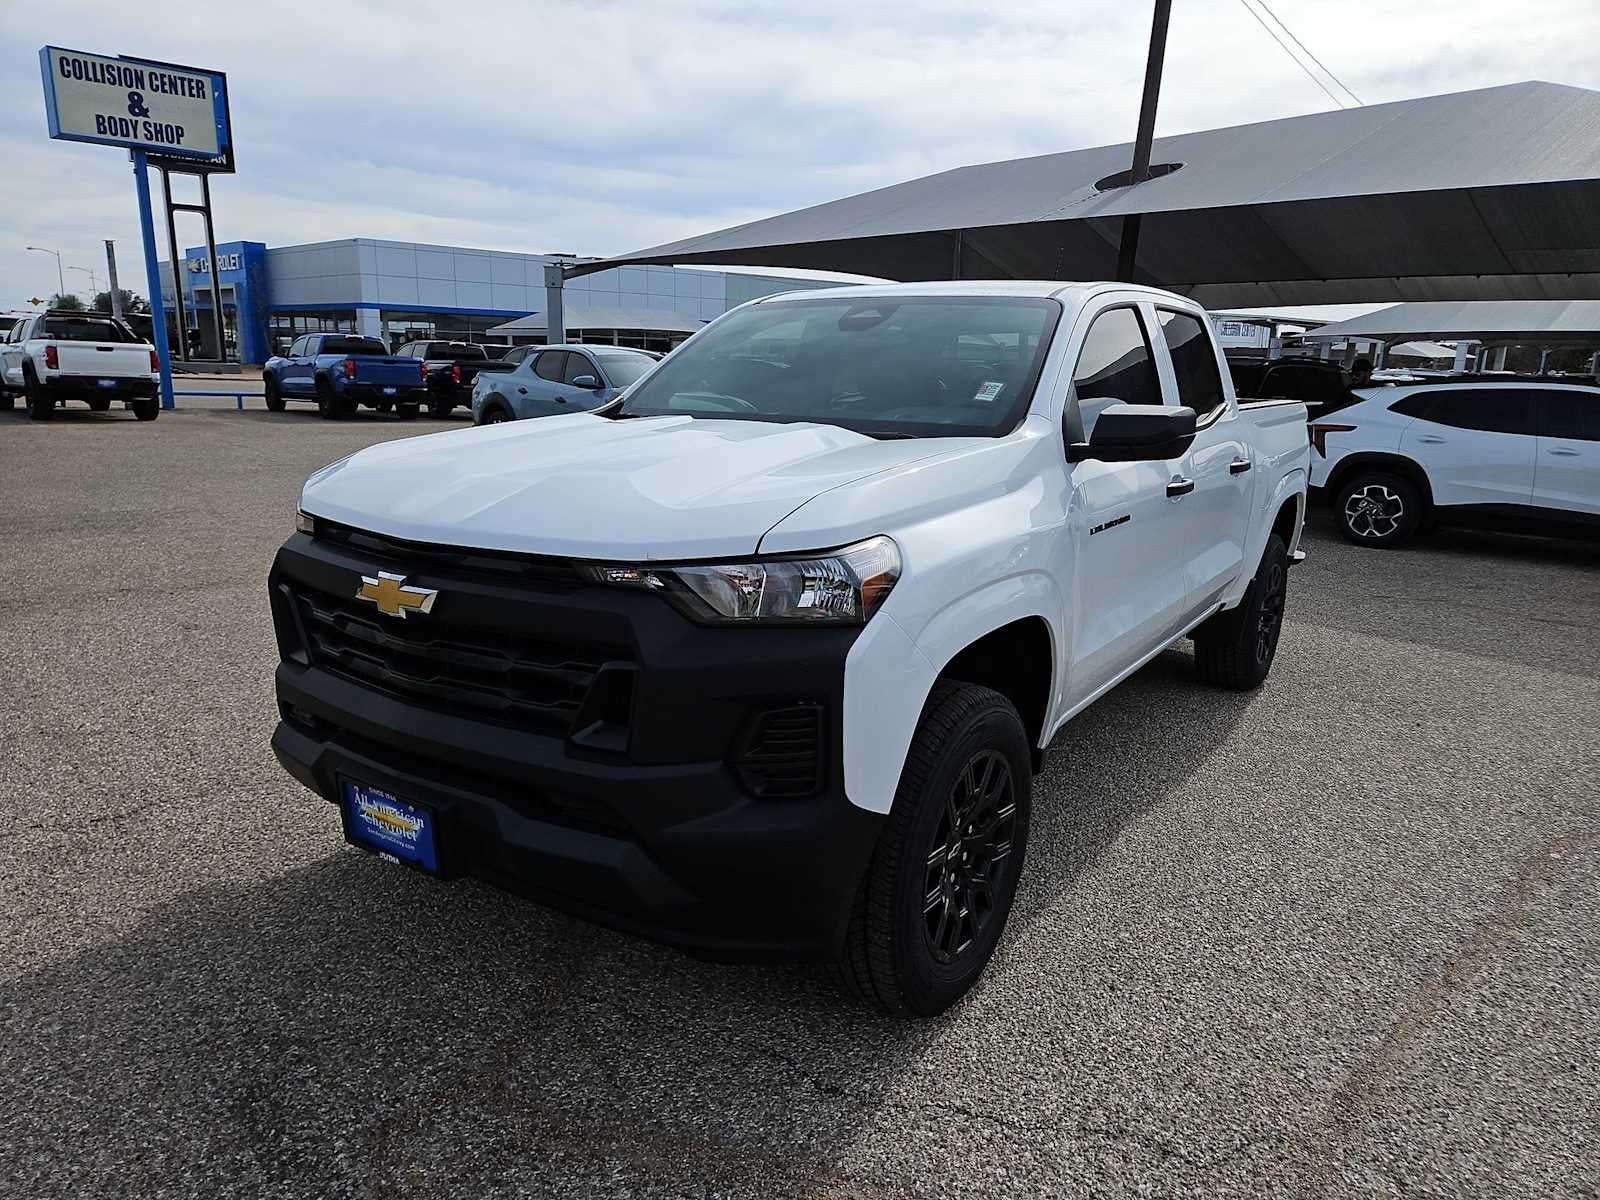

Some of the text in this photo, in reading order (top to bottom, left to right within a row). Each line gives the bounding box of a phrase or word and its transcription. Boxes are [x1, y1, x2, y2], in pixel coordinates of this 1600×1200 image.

[59, 56, 206, 100] COLLISION CENTER
[127, 91, 150, 118] &
[95, 114, 184, 145] BODY SHOP
[200, 253, 240, 273] CHROLET
[363, 811, 417, 842] Chevrolet
